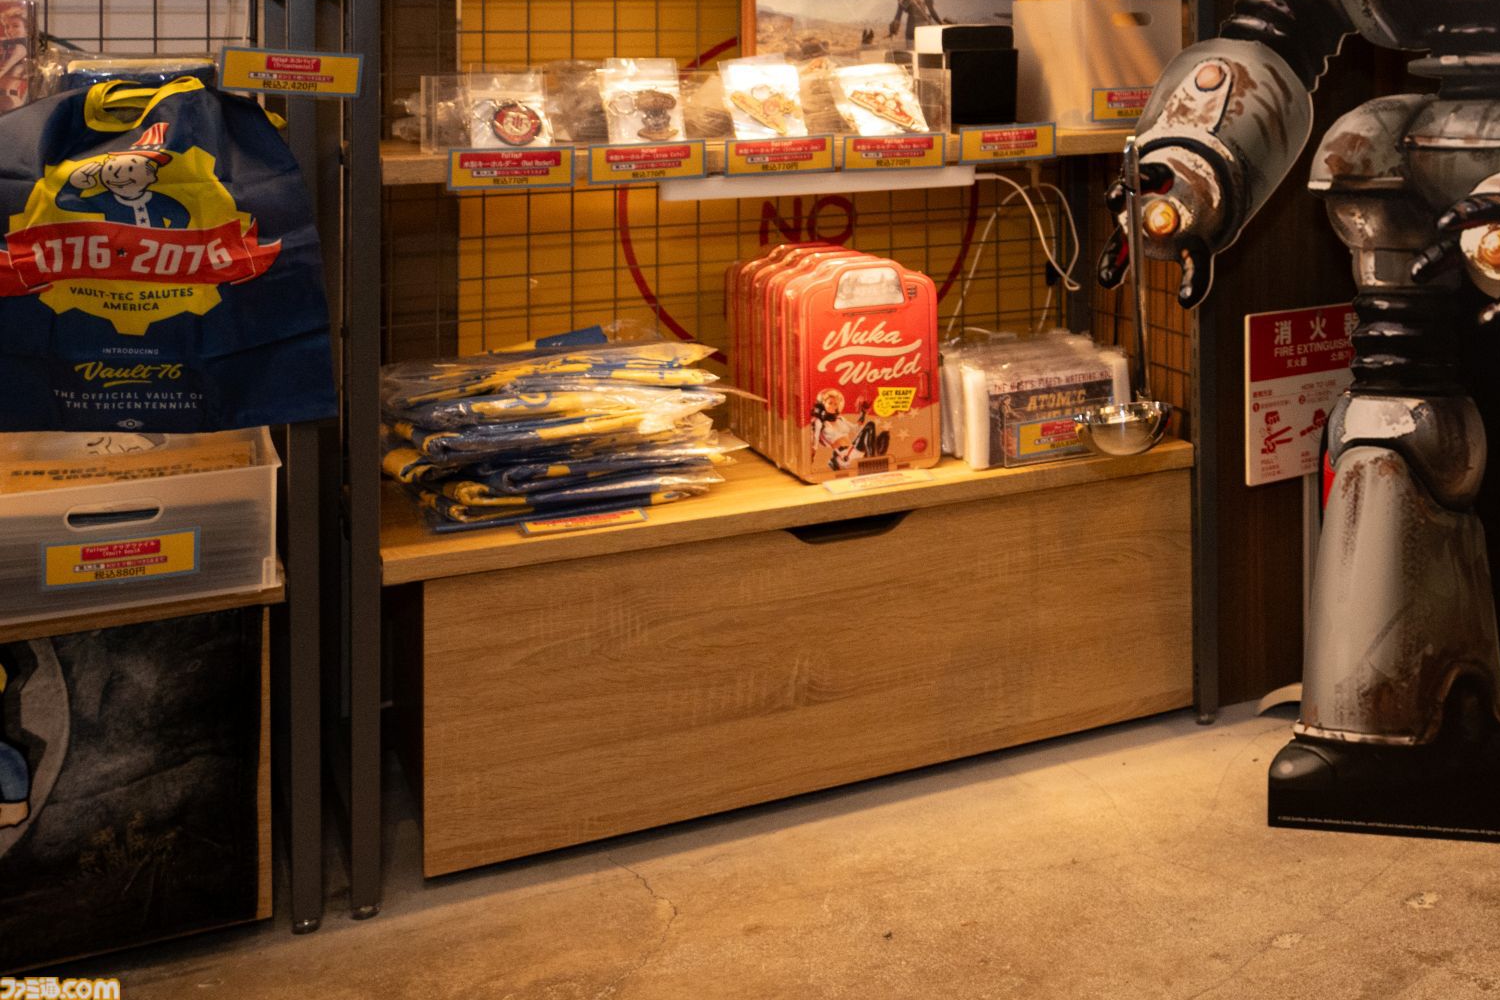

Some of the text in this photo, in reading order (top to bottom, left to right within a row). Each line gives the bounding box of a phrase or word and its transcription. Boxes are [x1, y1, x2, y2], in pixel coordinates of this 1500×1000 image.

[262, 79, 318, 91] 税込2,420円
[759, 196, 854, 247] NO
[32, 234, 233, 276] 1776 2076
[69, 286, 194, 301] VAULT-TEC SALUTES
[102, 302, 160, 311] AMERICA
[822, 316, 904, 351] Nuka
[1273, 312, 1360, 346] 消火器
[102, 347, 159, 355] INTRODUCING
[1274, 347, 1296, 358] FIRE
[74, 361, 184, 382] Vault 76
[834, 352, 921, 386] World
[54, 389, 76, 400] THE
[81, 391, 140, 401] OFFICIAL
[146, 391, 184, 400] VAULT
[881, 389, 913, 397] GET READY
[65, 401, 198, 410] THE TRICENTENNIAL
[1026, 389, 1087, 412] ATOMIC
[94, 566, 146, 580] 税込880円
